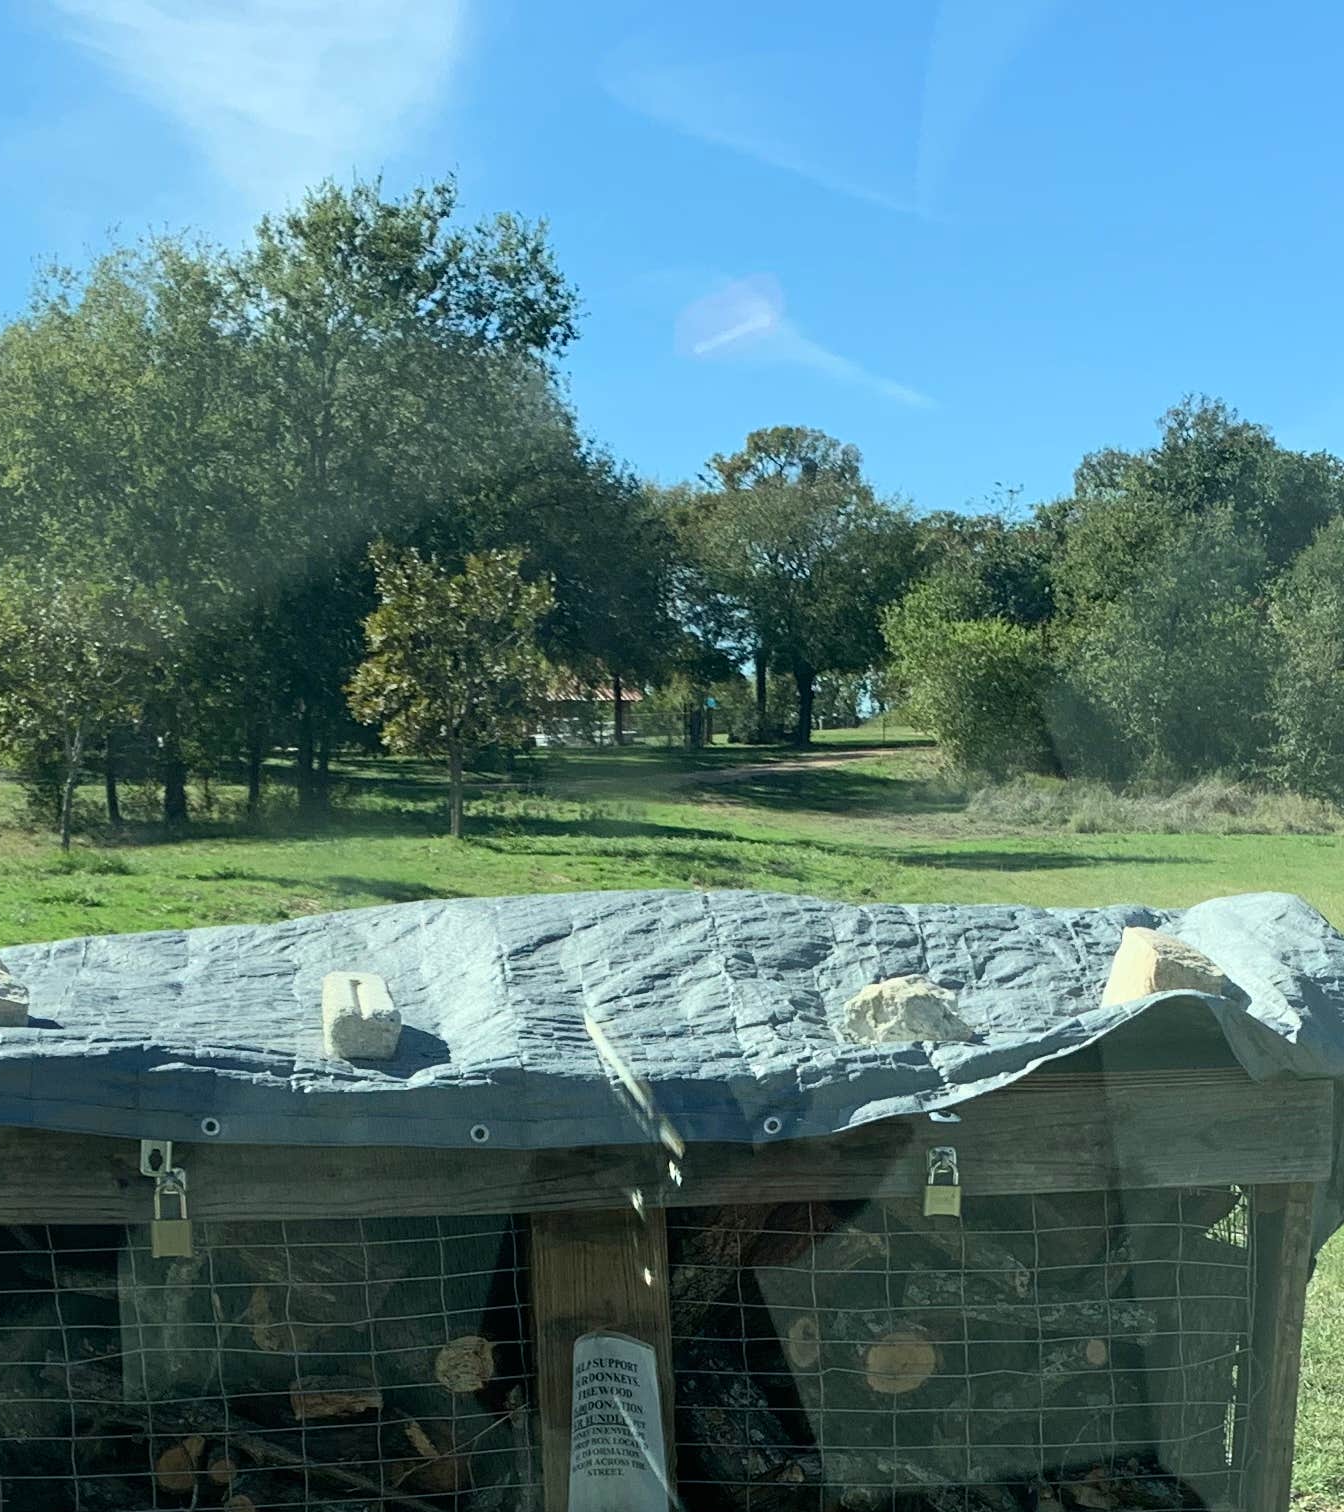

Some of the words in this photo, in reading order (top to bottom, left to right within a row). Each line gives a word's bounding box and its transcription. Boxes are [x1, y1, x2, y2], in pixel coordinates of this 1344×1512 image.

[592, 1358, 638, 1373] SUPPORT
[578, 1386, 632, 1400] FIREWOOD
[592, 1427, 602, 1435] IN
[604, 1427, 645, 1440] ENVELPE
[591, 1437, 609, 1446] BOX
[613, 1438, 648, 1450] LOCATD
[595, 1458, 630, 1467] ACROSS
